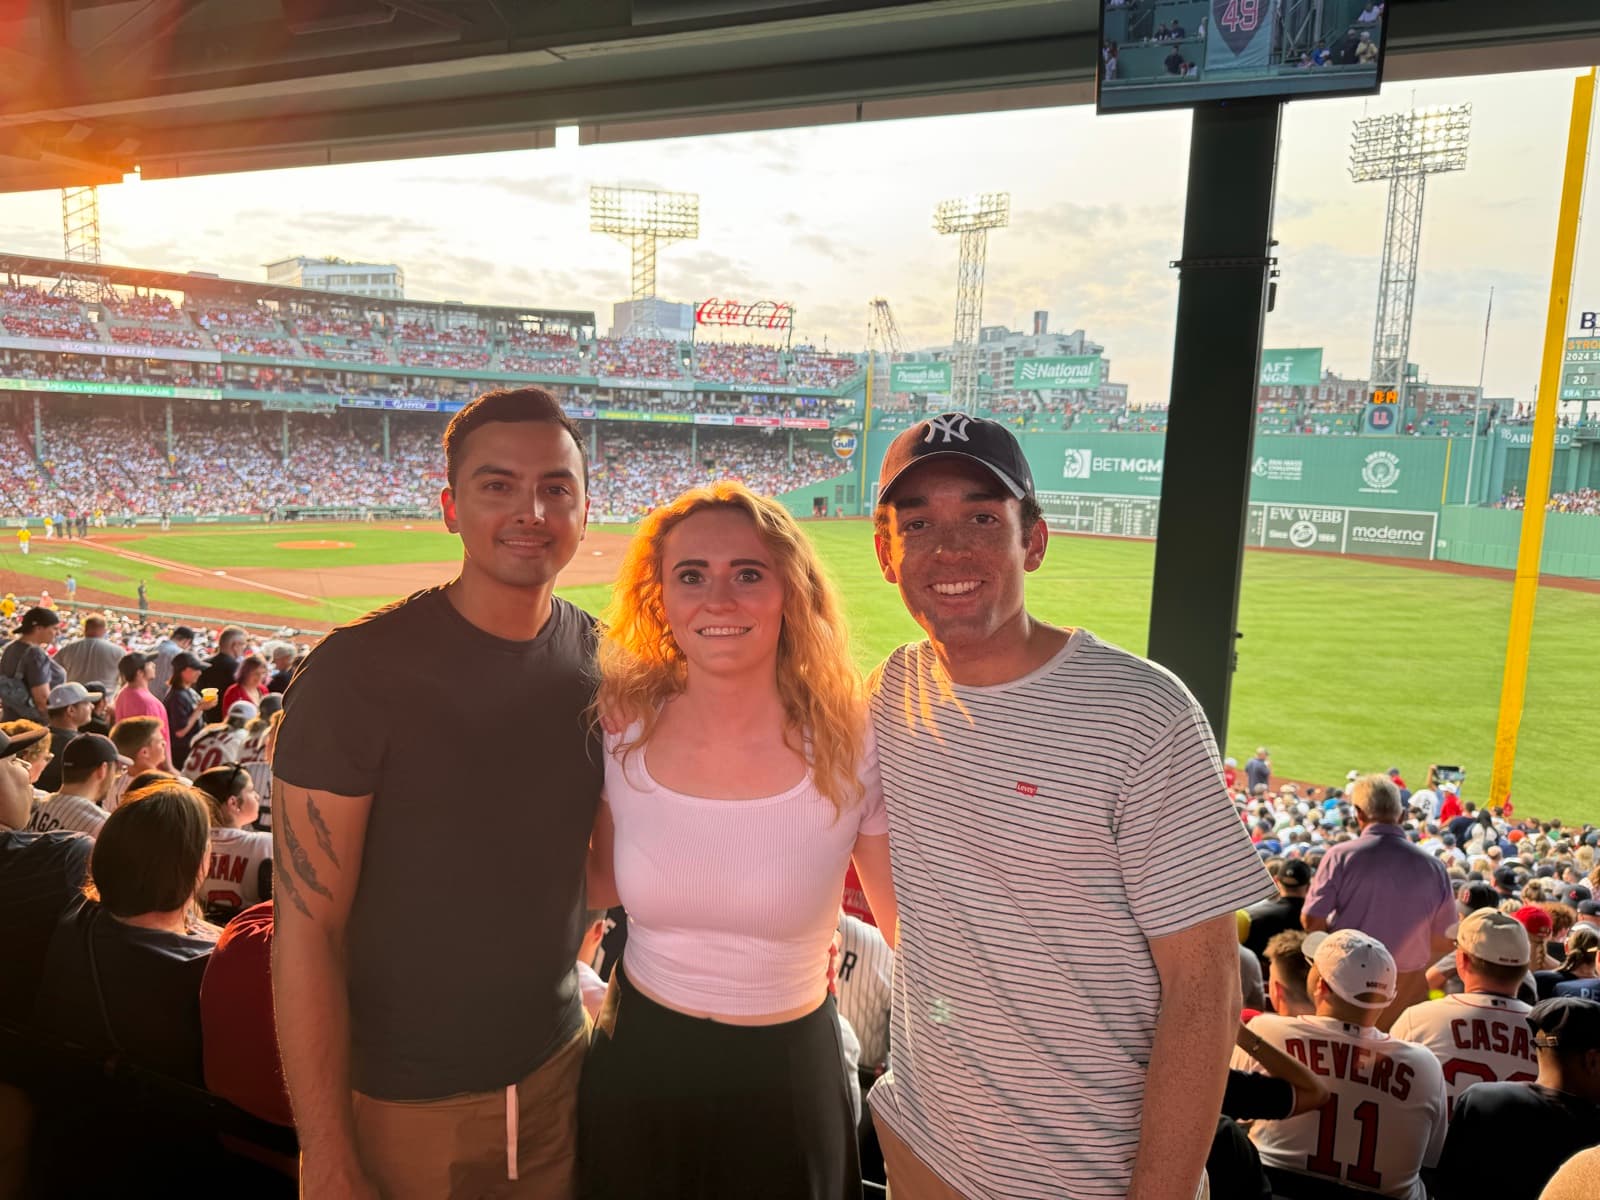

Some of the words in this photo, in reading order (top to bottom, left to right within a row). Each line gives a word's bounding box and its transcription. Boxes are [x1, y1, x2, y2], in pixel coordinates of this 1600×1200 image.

[1222, 0, 1258, 32] 49
[1036, 362, 1094, 378] National
[832, 439, 855, 450] Gulf
[1297, 509, 1343, 524] WEBB
[1352, 525, 1425, 542] moderna
[1285, 1038, 1415, 1102] DEVERS
[1307, 1092, 1382, 1188] 11
